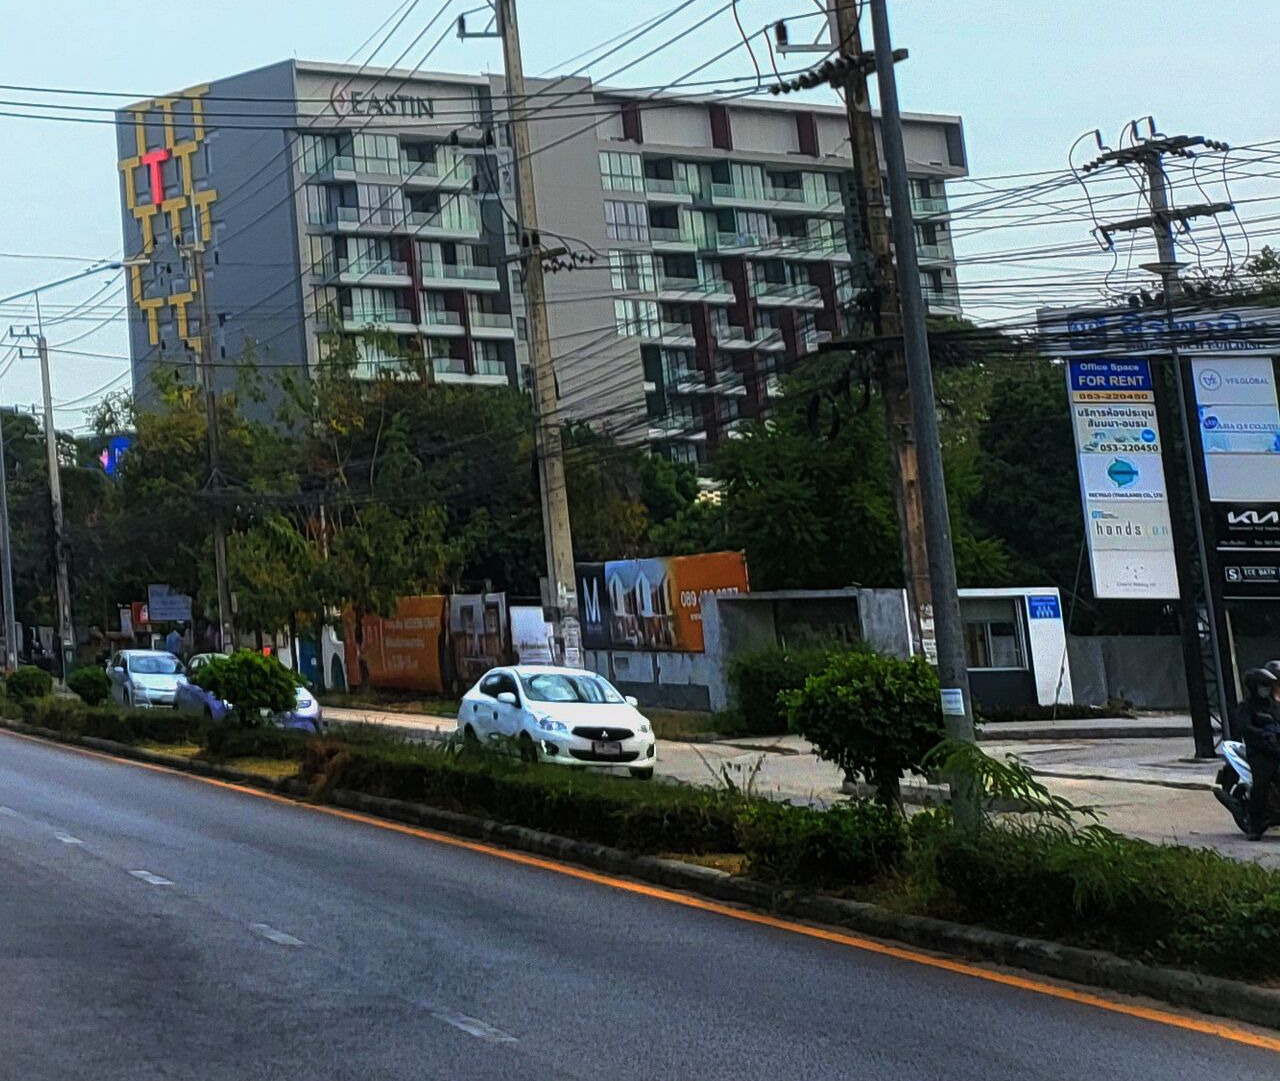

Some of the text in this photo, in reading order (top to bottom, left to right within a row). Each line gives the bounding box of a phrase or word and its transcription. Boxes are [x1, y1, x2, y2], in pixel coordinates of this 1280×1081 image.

[351, 90, 434, 119] EASTIN
[1080, 362, 1140, 372] Office Space
[1078, 375, 1145, 387] FOR RENT
[1100, 443, 1159, 452] 053-220450
[1096, 521, 1142, 536] hands
